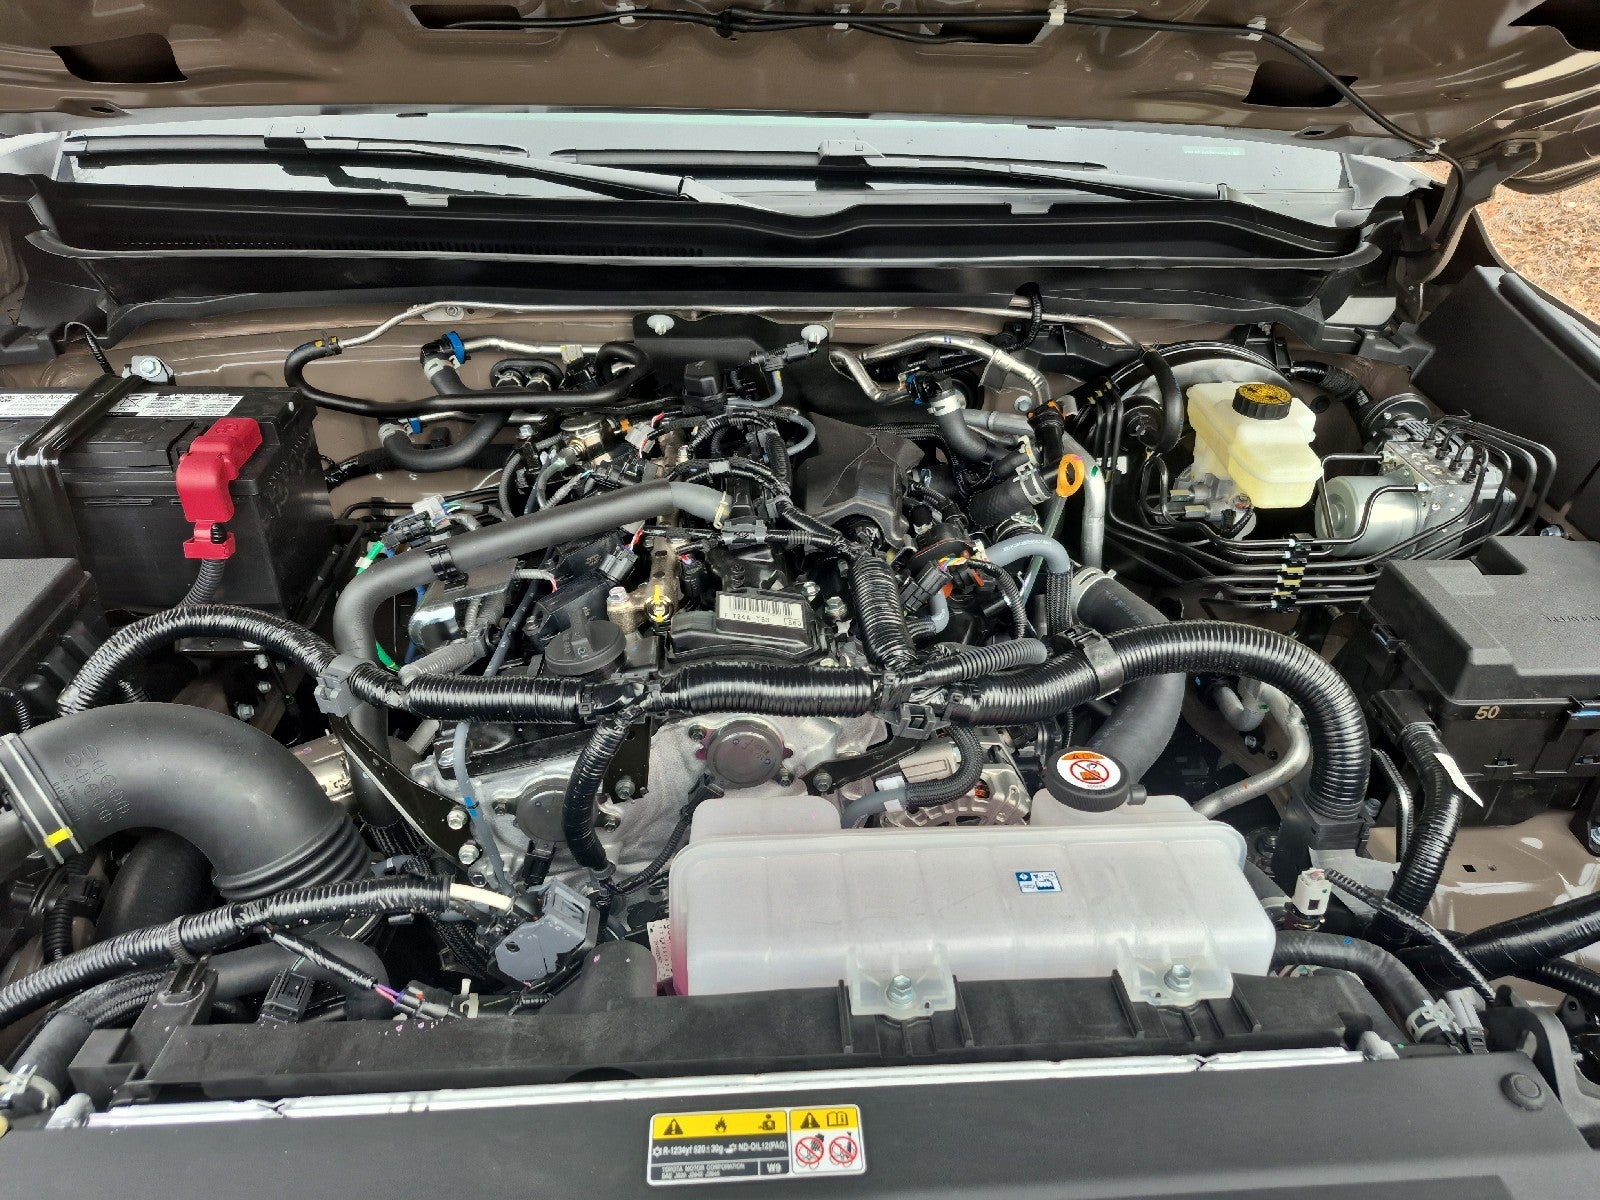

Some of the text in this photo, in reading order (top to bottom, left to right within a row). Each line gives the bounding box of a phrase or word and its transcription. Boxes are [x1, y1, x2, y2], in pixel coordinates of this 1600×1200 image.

[1475, 705, 1500, 720] 50
[662, 1162, 746, 1173] TOYOTA MOTOR CORPORATION
